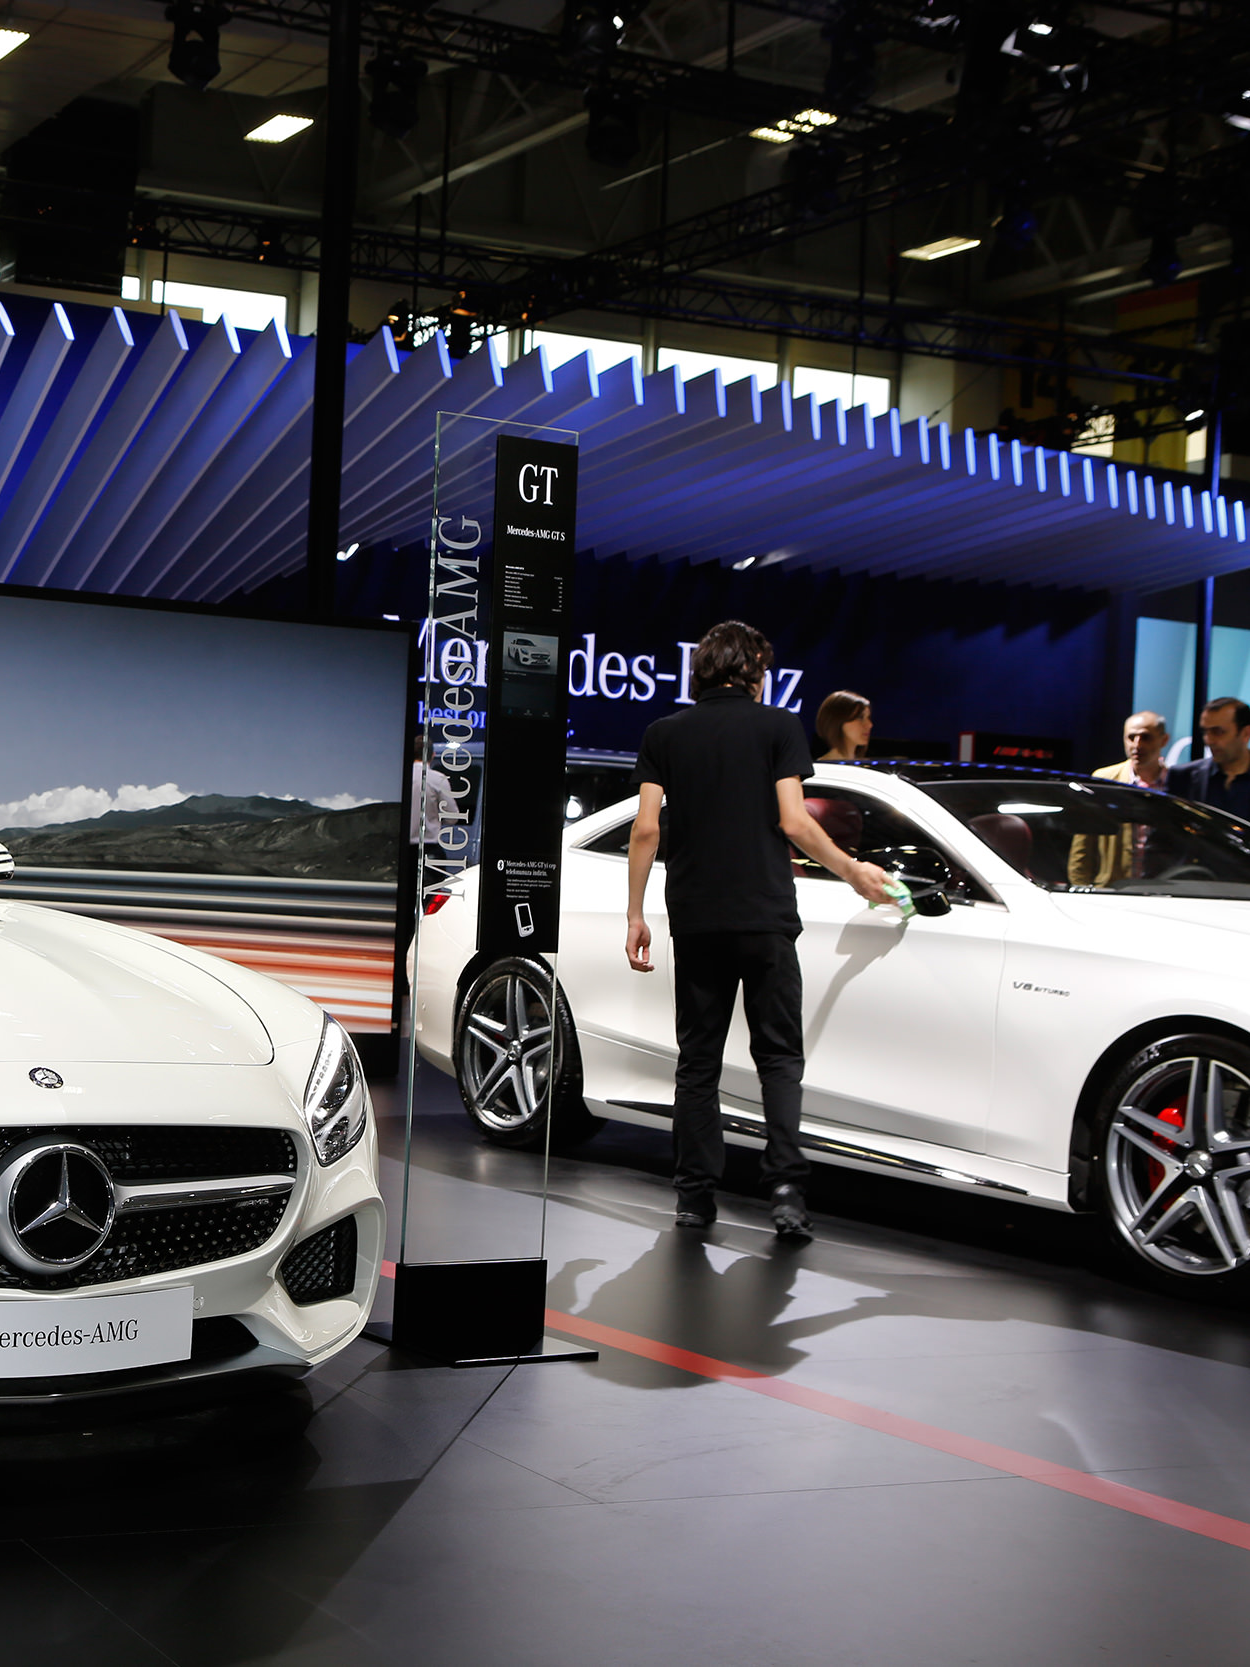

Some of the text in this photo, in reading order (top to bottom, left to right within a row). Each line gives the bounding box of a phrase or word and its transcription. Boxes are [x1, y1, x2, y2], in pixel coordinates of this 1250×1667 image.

[518, 463, 558, 505] GT
[506, 524, 566, 542] Mercedes-AMG GT S
[423, 515, 483, 902] Mercedes-AMG
